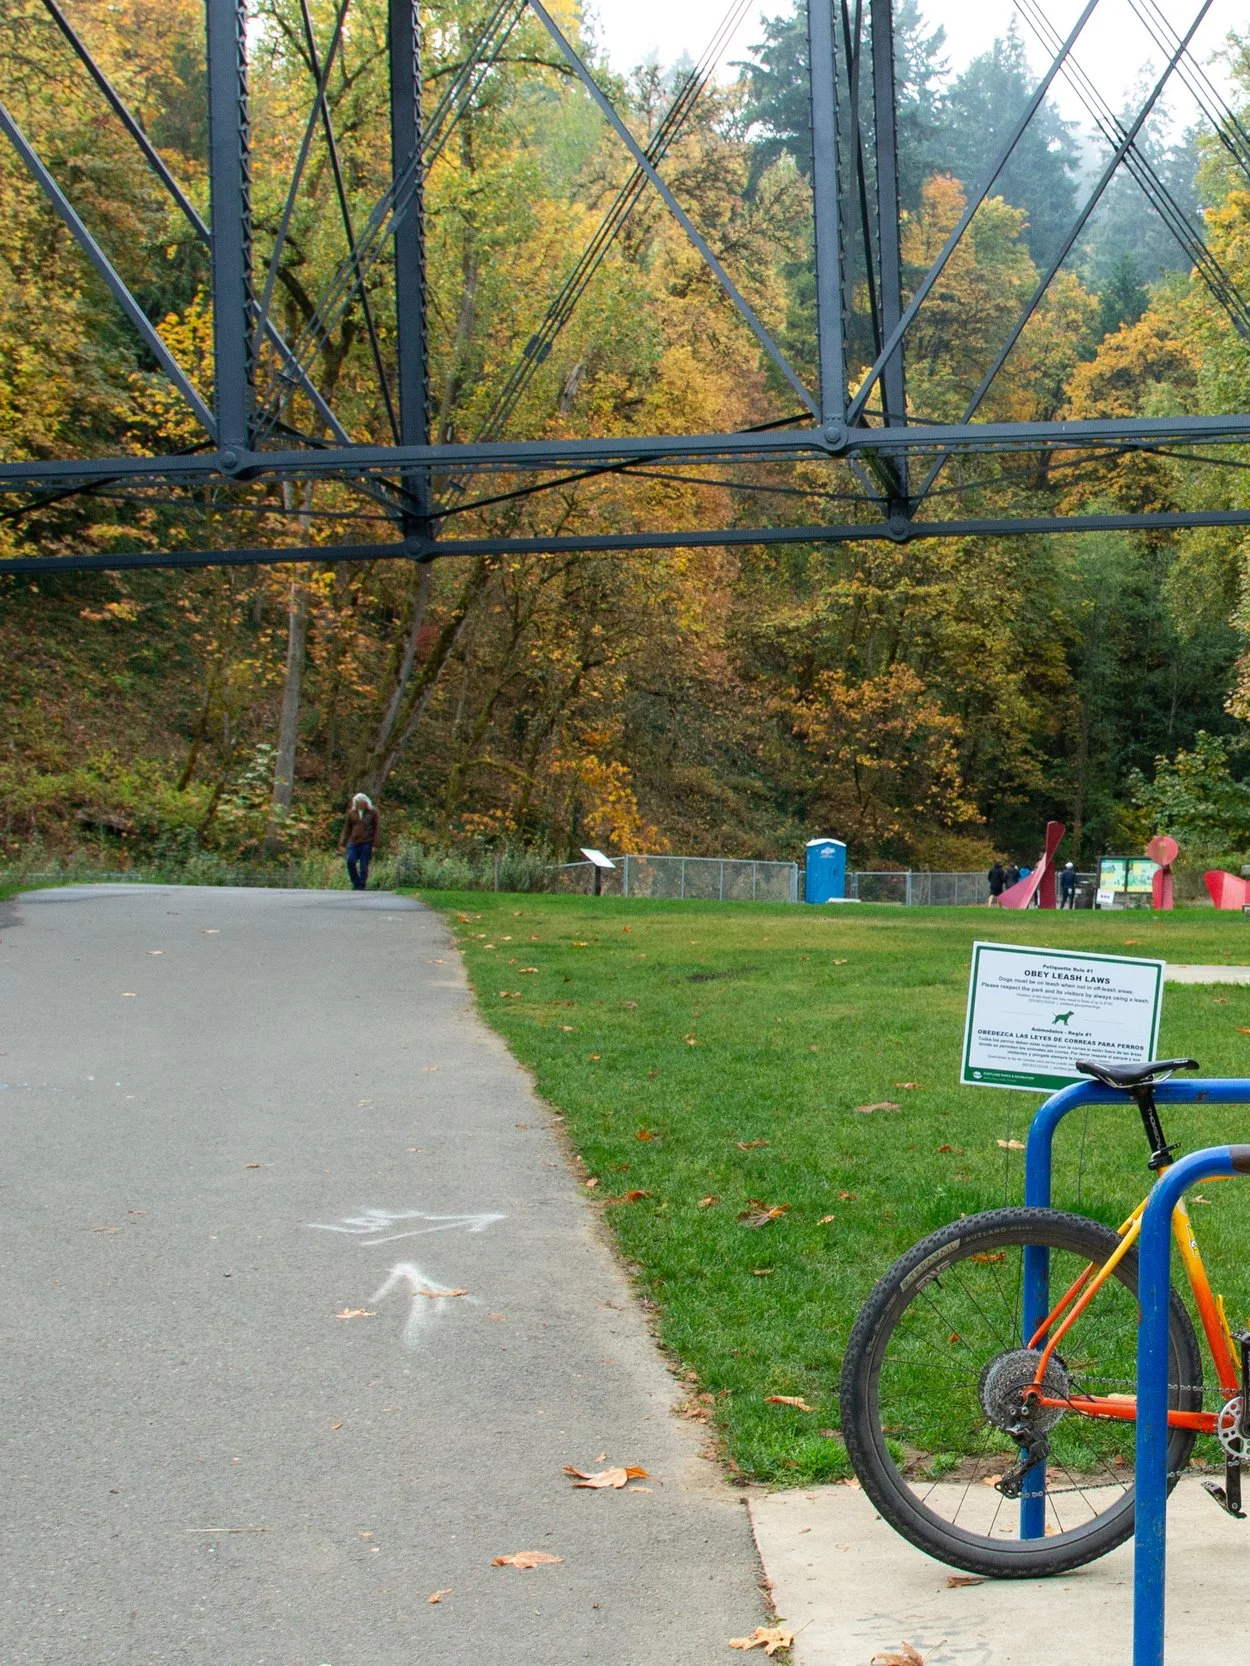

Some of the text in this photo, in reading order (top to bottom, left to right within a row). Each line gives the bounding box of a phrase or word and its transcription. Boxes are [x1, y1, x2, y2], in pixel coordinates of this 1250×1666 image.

[1024, 969, 1111, 984] OBEY LEASH LAWS
[977, 1029, 1014, 1037] OBEDEZCA
[1064, 1038, 1096, 1046] CORREAS
[1117, 1043, 1144, 1051] PERROS
